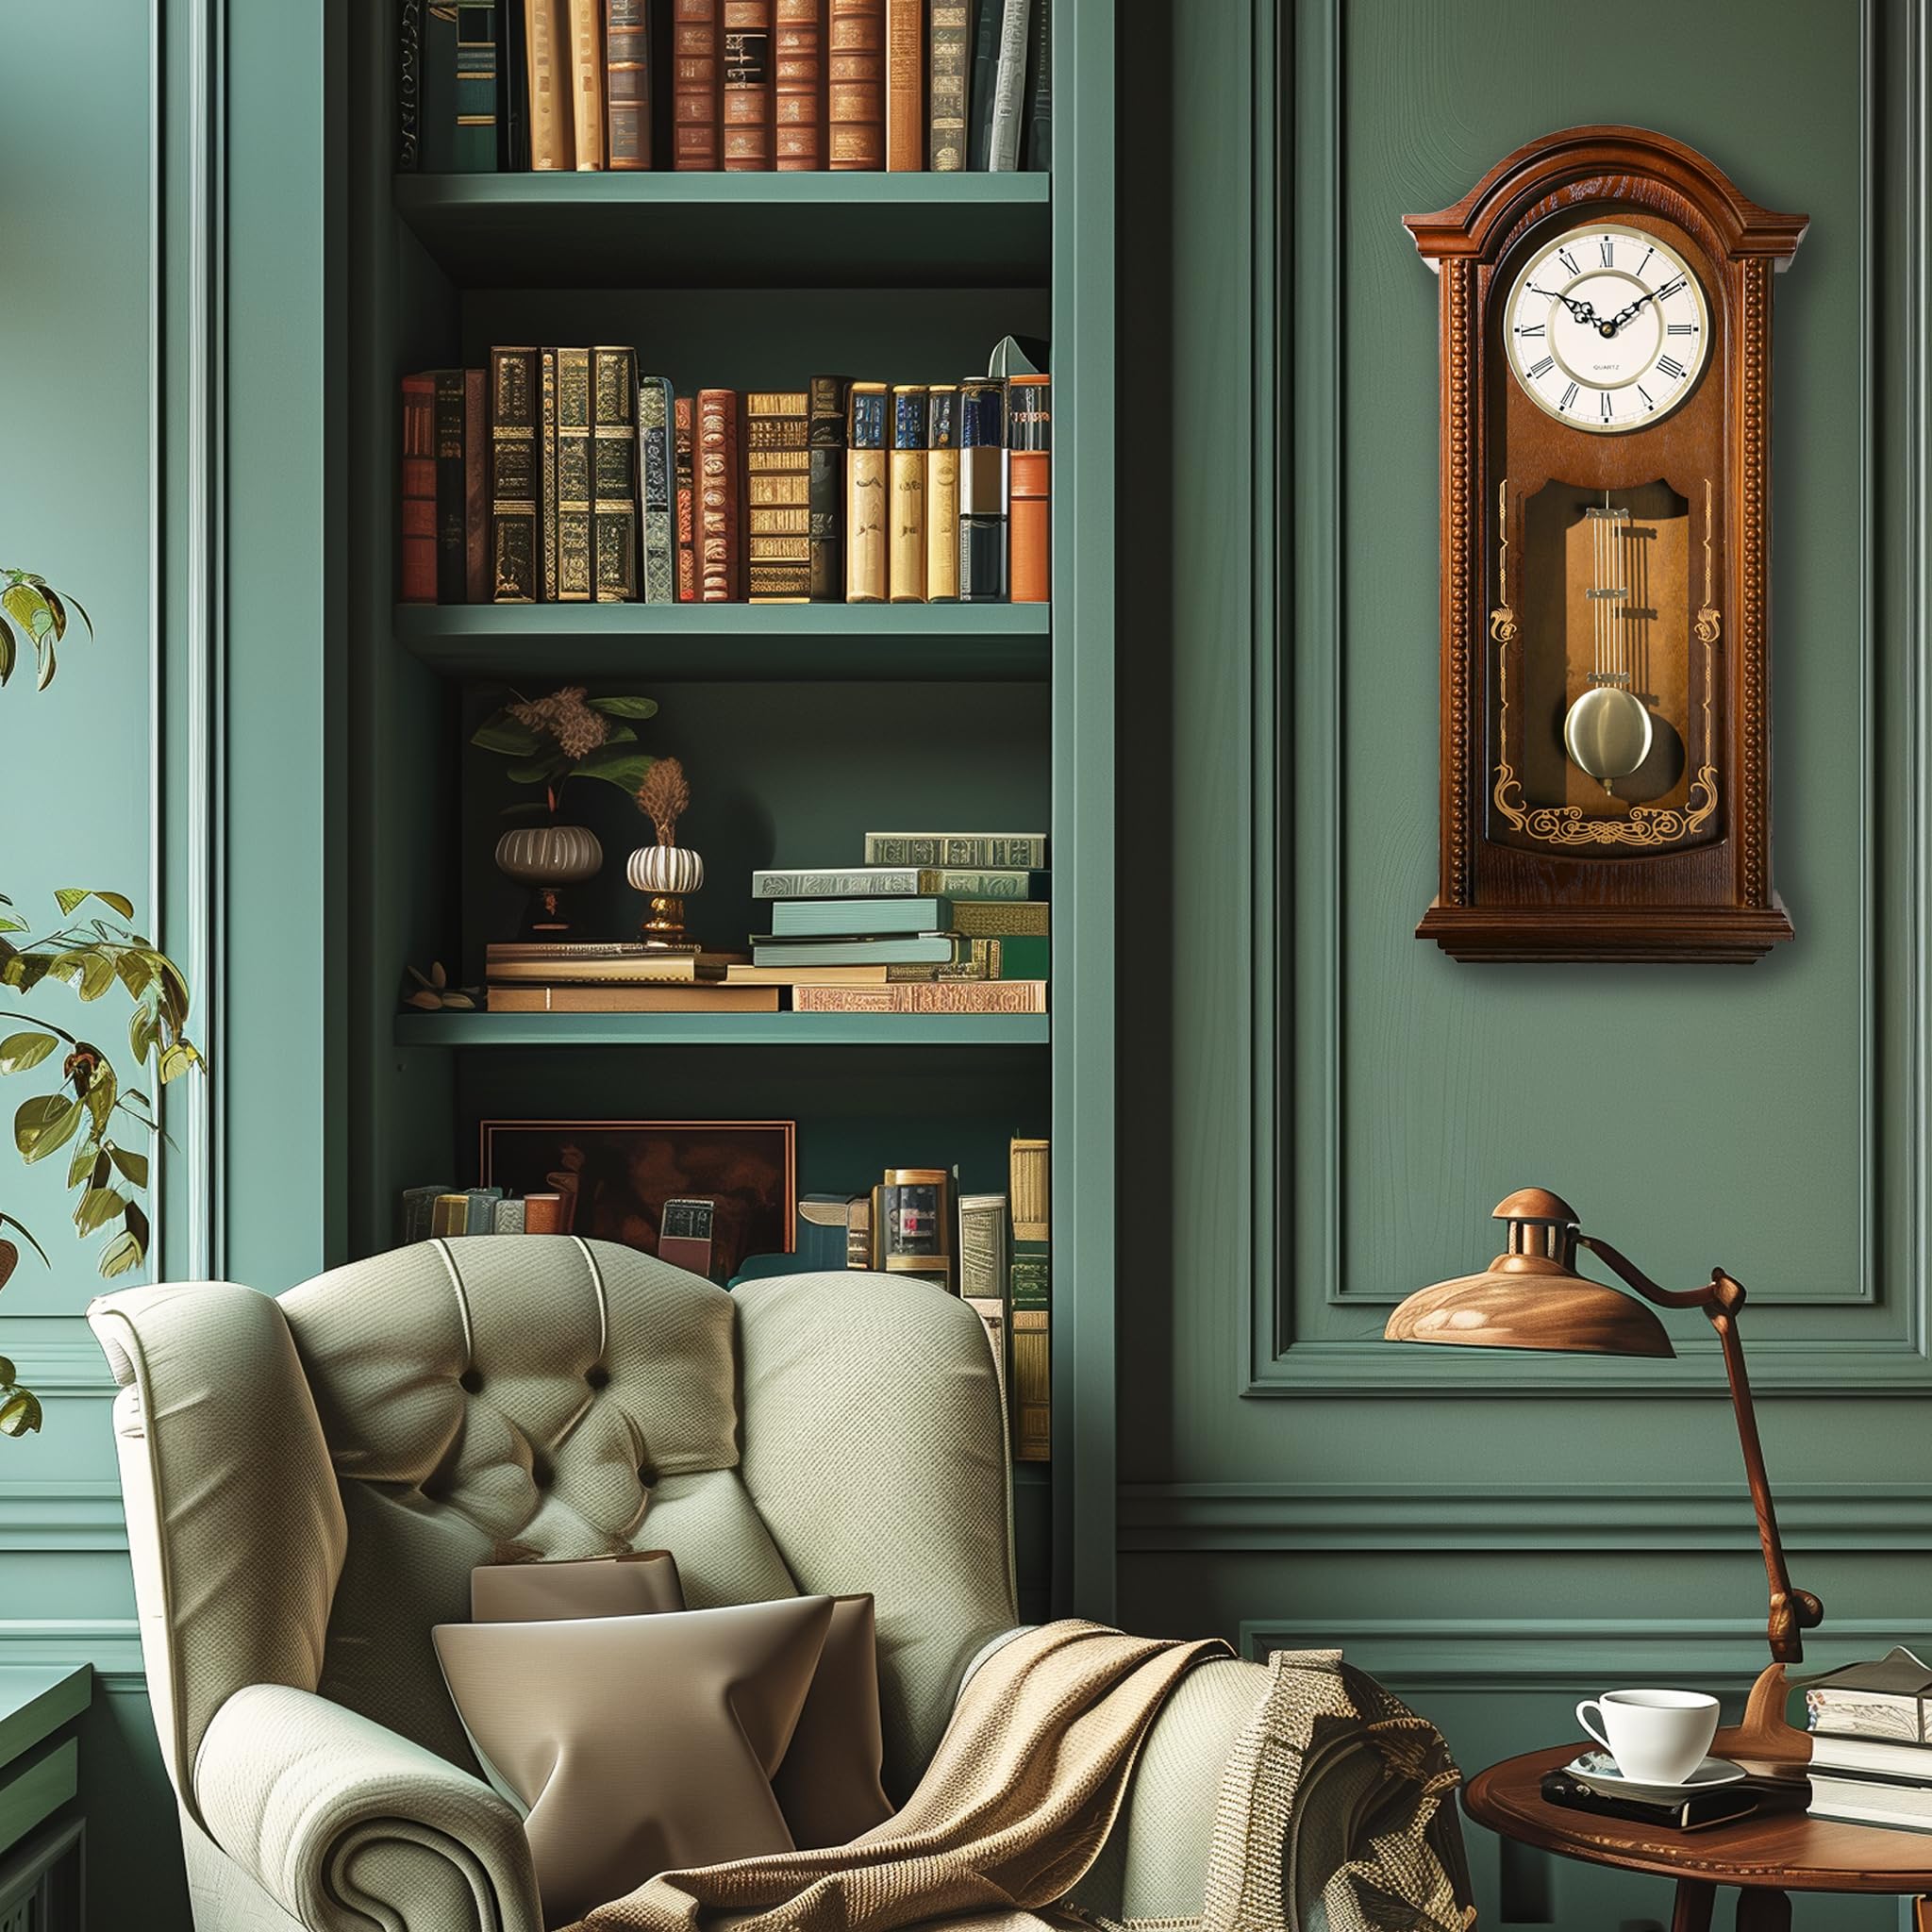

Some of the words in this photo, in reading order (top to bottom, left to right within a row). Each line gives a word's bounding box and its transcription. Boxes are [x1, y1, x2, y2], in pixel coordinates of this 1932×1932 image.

[1559, 252, 1581, 278] XI
[1599, 242, 1613, 267] XII
[1637, 254, 1651, 276] I
[1531, 283, 1556, 303] X
[1658, 282, 1682, 302] II
[1521, 324, 1545, 337] IX
[1668, 325, 1691, 335] III
[1530, 356, 1555, 379] VIII
[1560, 382, 1580, 408] VII
[1600, 392, 1613, 416] VI
[1637, 384, 1653, 407] V
